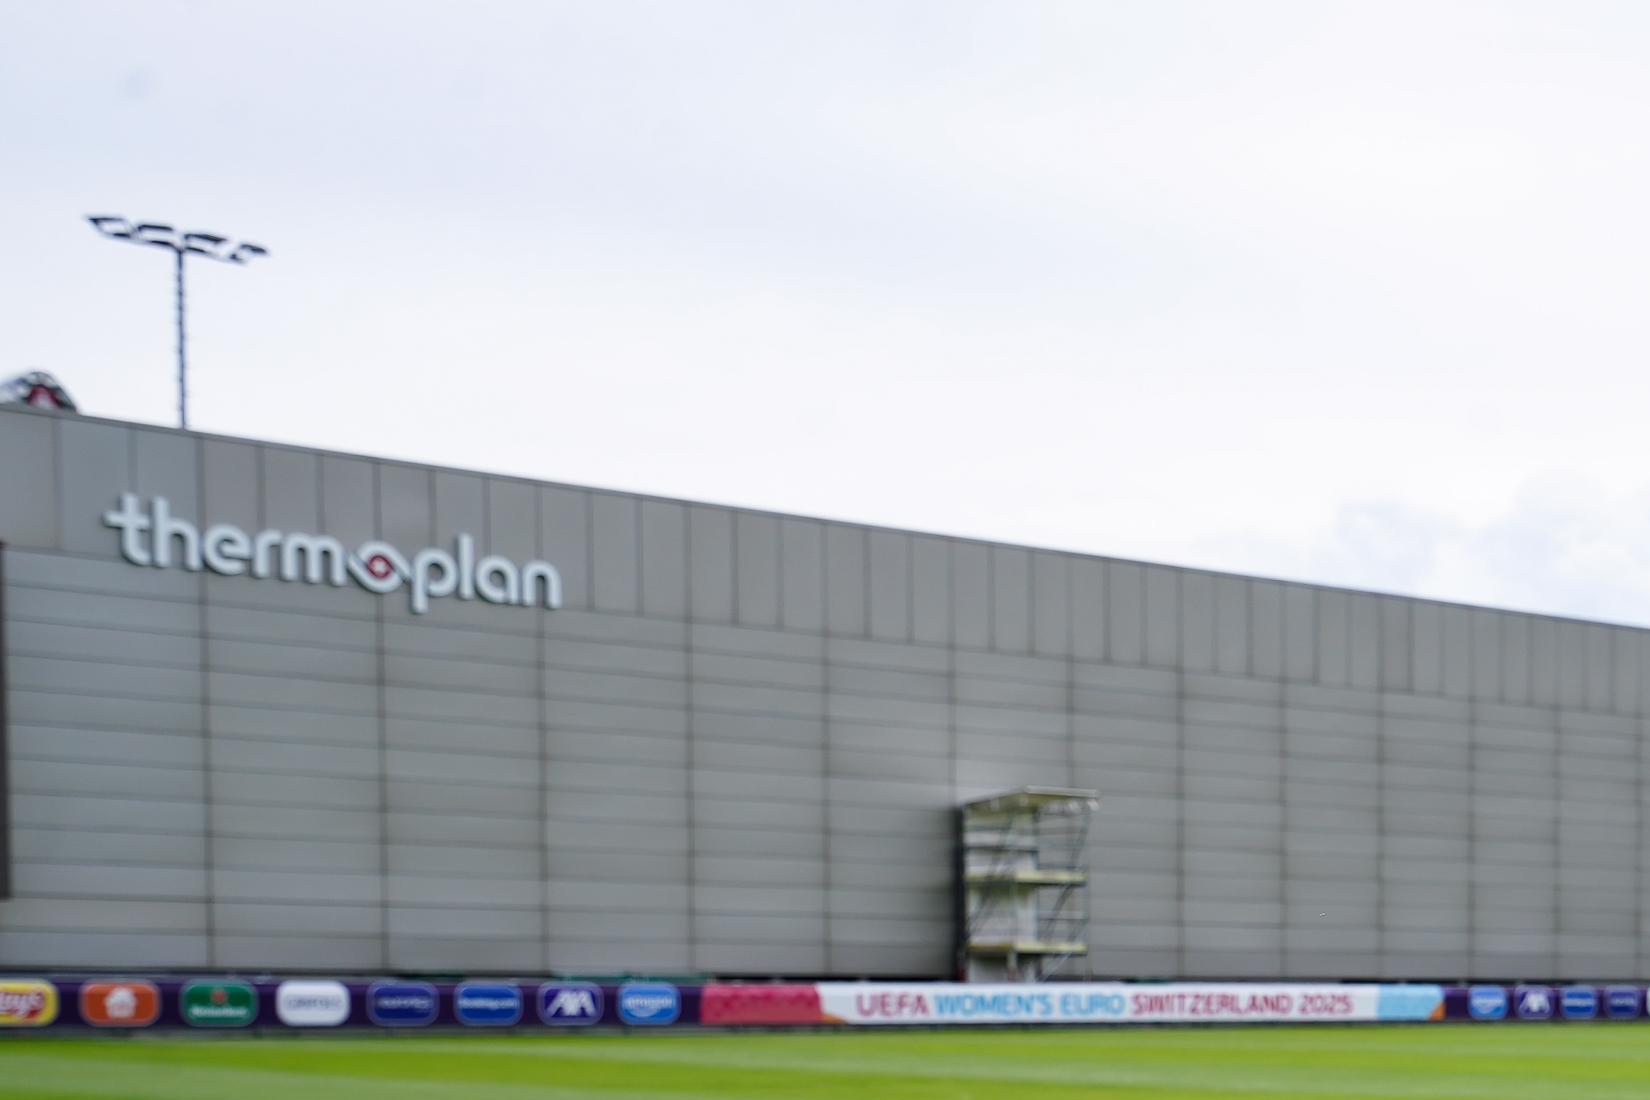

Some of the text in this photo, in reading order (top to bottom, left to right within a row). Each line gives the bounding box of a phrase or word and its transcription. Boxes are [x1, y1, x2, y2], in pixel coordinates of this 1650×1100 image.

[104, 492, 563, 614] thermoplan
[855, 991, 1354, 1017] UEFA WOMEN'S EURO SWITZERLAND 2025
